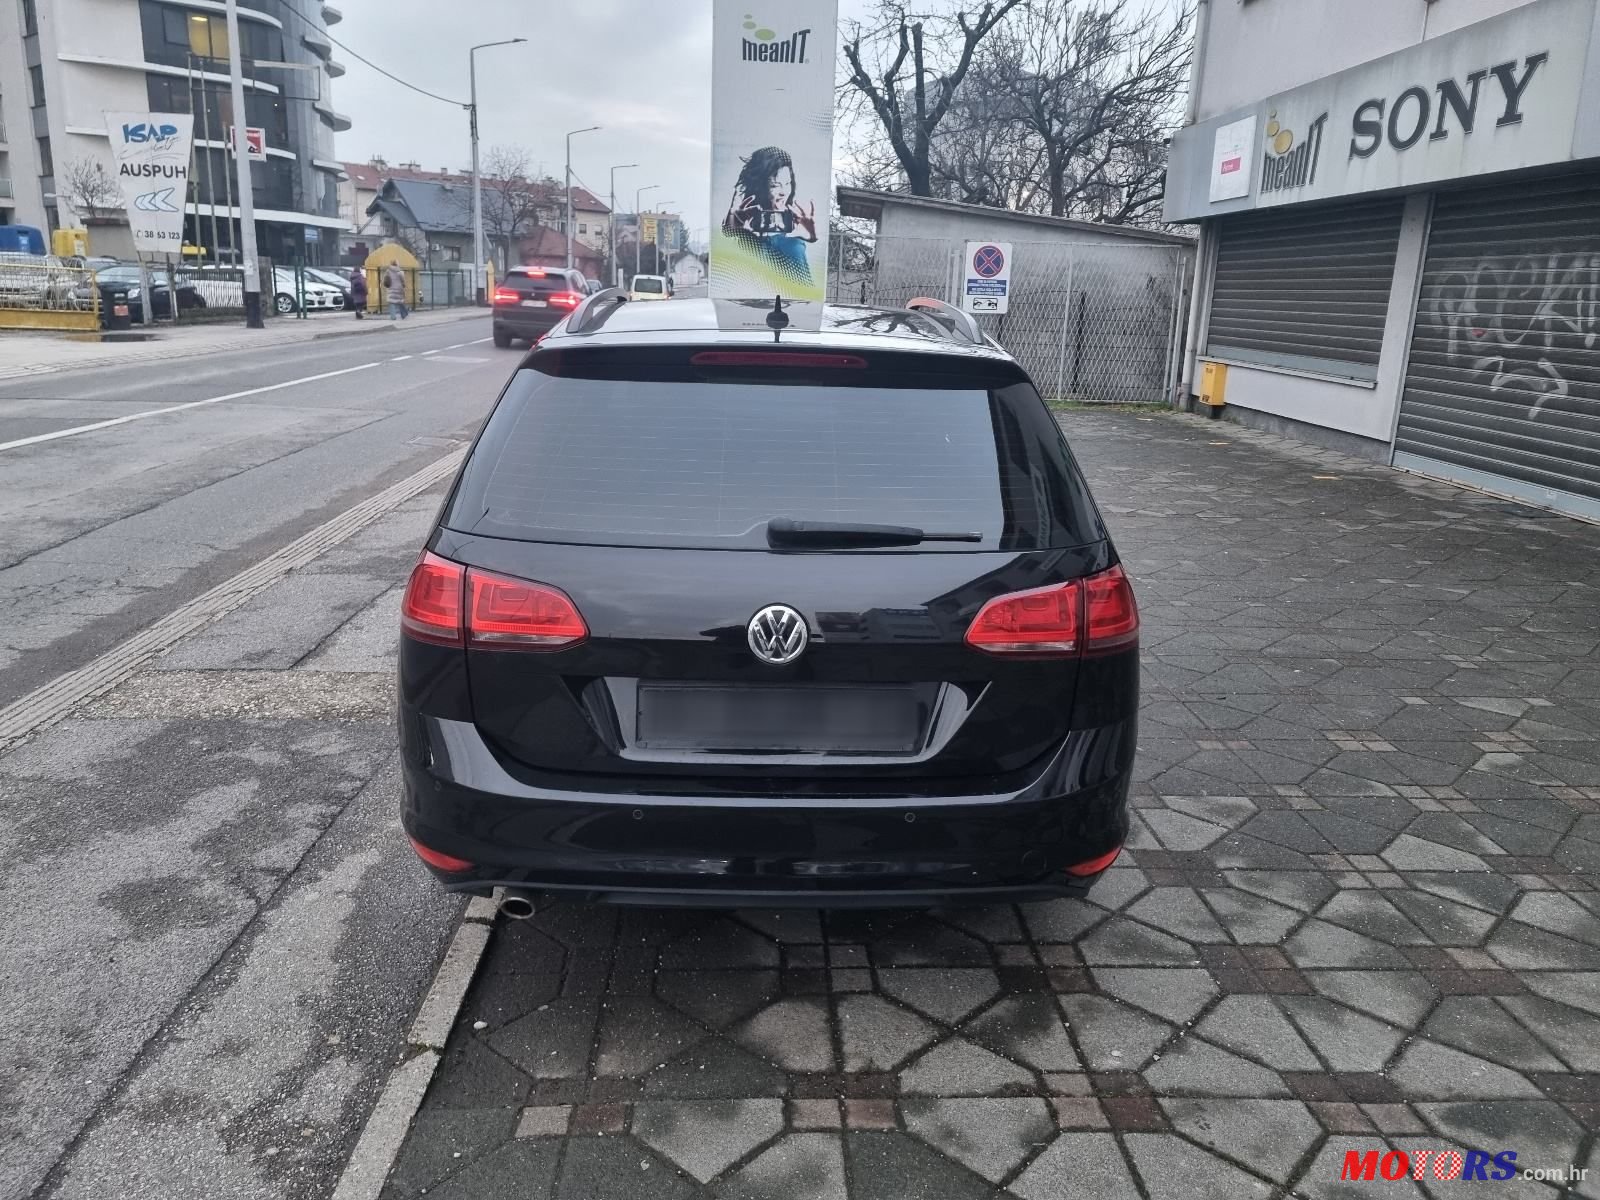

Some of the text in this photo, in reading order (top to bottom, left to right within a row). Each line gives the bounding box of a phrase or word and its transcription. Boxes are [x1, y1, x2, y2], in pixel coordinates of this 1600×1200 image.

[742, 29, 811, 64] meanIT
[1349, 51, 1549, 161] SONY
[122, 123, 178, 143] ISAP
[1261, 112, 1329, 193] meanIT
[119, 163, 187, 179] AUSPUH
[144, 230, 154, 239] 38
[168, 231, 181, 240] 123
